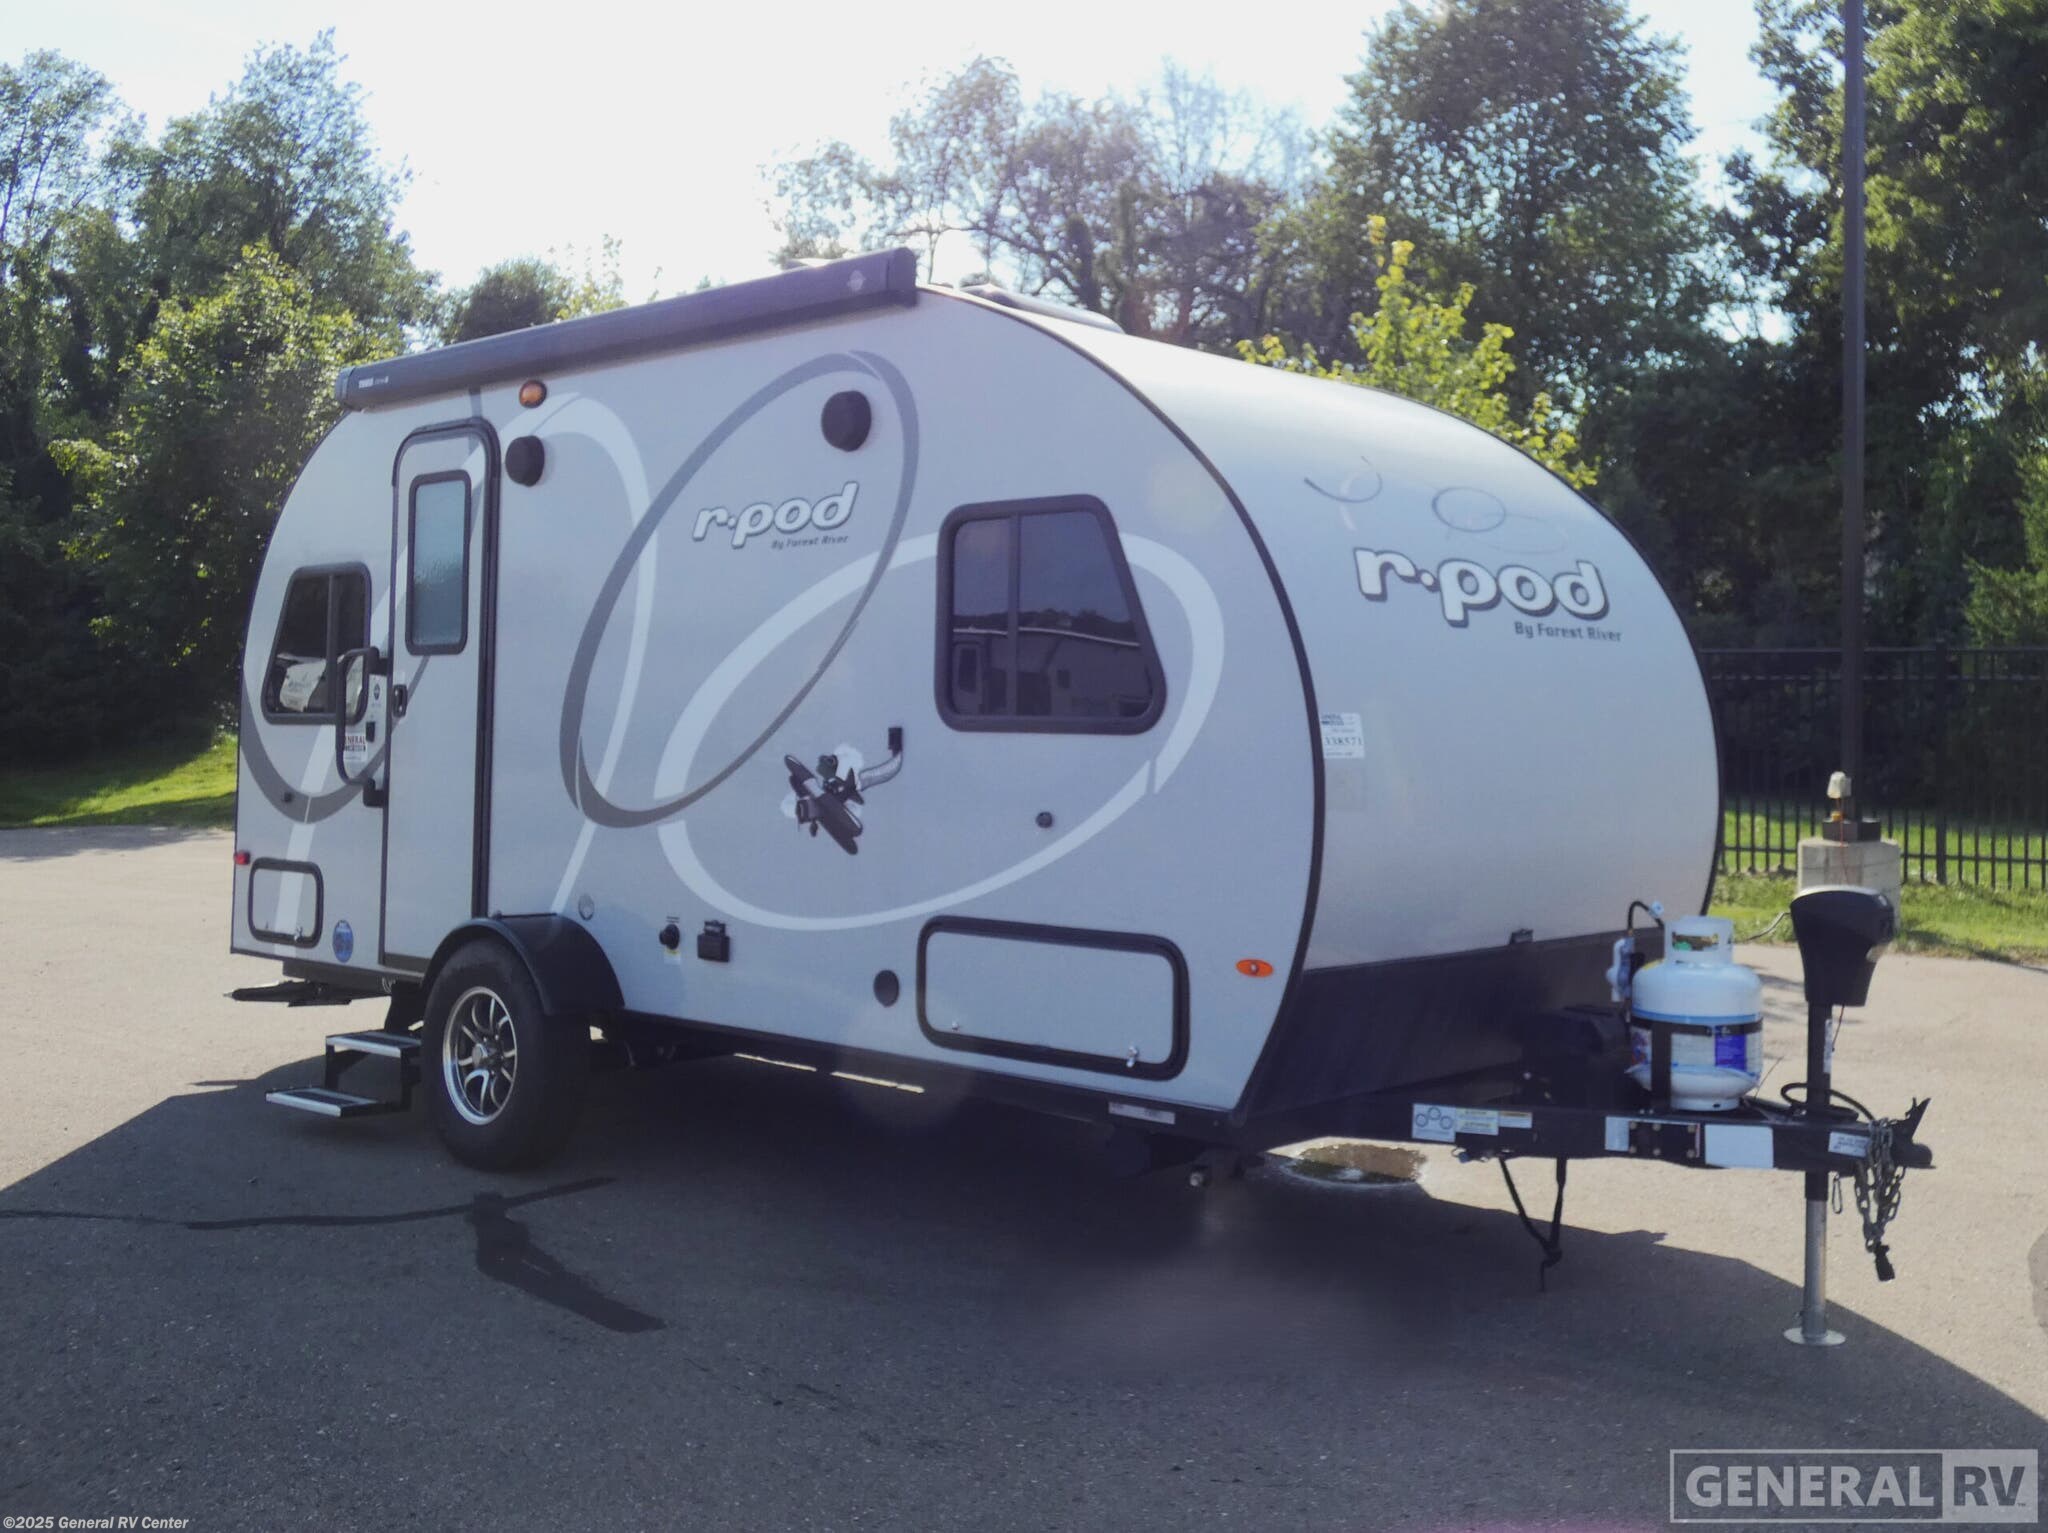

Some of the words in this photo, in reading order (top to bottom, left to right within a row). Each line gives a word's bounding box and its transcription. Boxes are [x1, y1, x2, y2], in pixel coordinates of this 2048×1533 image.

[786, 537, 819, 548] Forest
[821, 535, 849, 545] River
[1514, 621, 1534, 639] By
[1537, 623, 1583, 639] Forest
[1587, 627, 1623, 642] River
